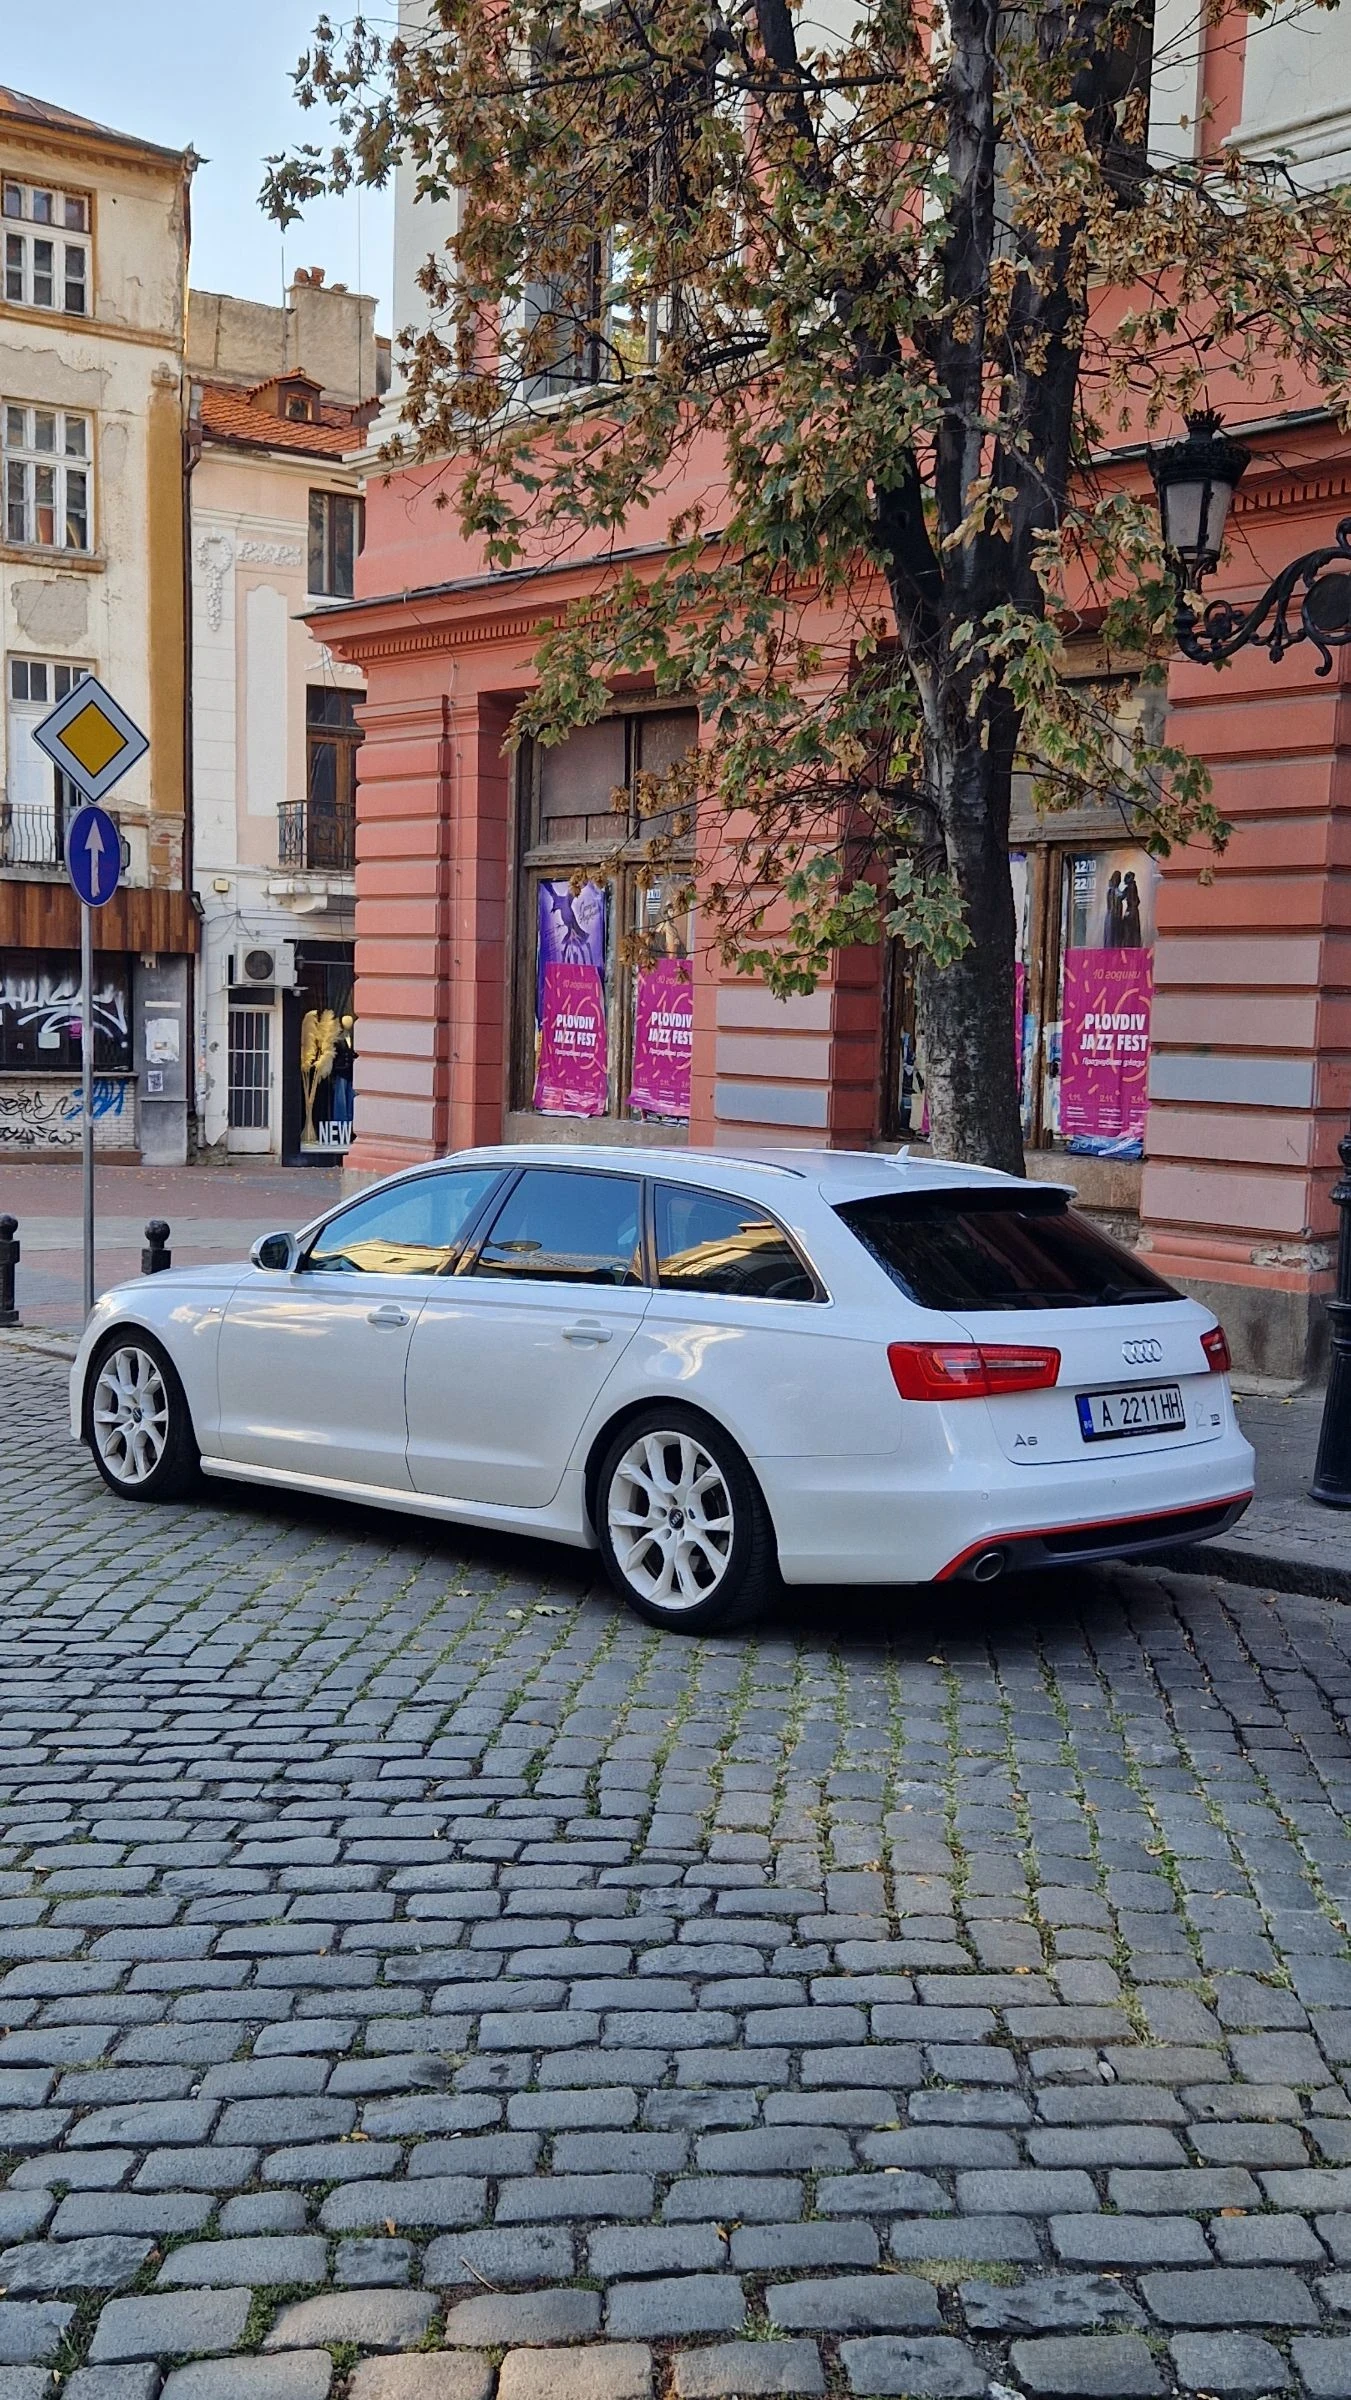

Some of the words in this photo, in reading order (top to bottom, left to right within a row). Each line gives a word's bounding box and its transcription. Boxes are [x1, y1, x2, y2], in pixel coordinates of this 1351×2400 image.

[556, 1014, 596, 1030] PLOVDIV
[651, 1011, 693, 1028] PLOVDIV
[1084, 1013, 1146, 1031] PLOVDIV
[554, 1030, 576, 1044] JAZZ
[576, 1031, 597, 1047] FEST
[648, 1028, 671, 1043] JAZZ
[672, 1029, 693, 1045] FEST
[1080, 1033, 1114, 1051] JAZZ
[1116, 1034, 1149, 1052] FEST
[319, 1121, 352, 1145] NEW
[1102, 1400, 1114, 1428] A
[1014, 1433, 1038, 1448] A6
